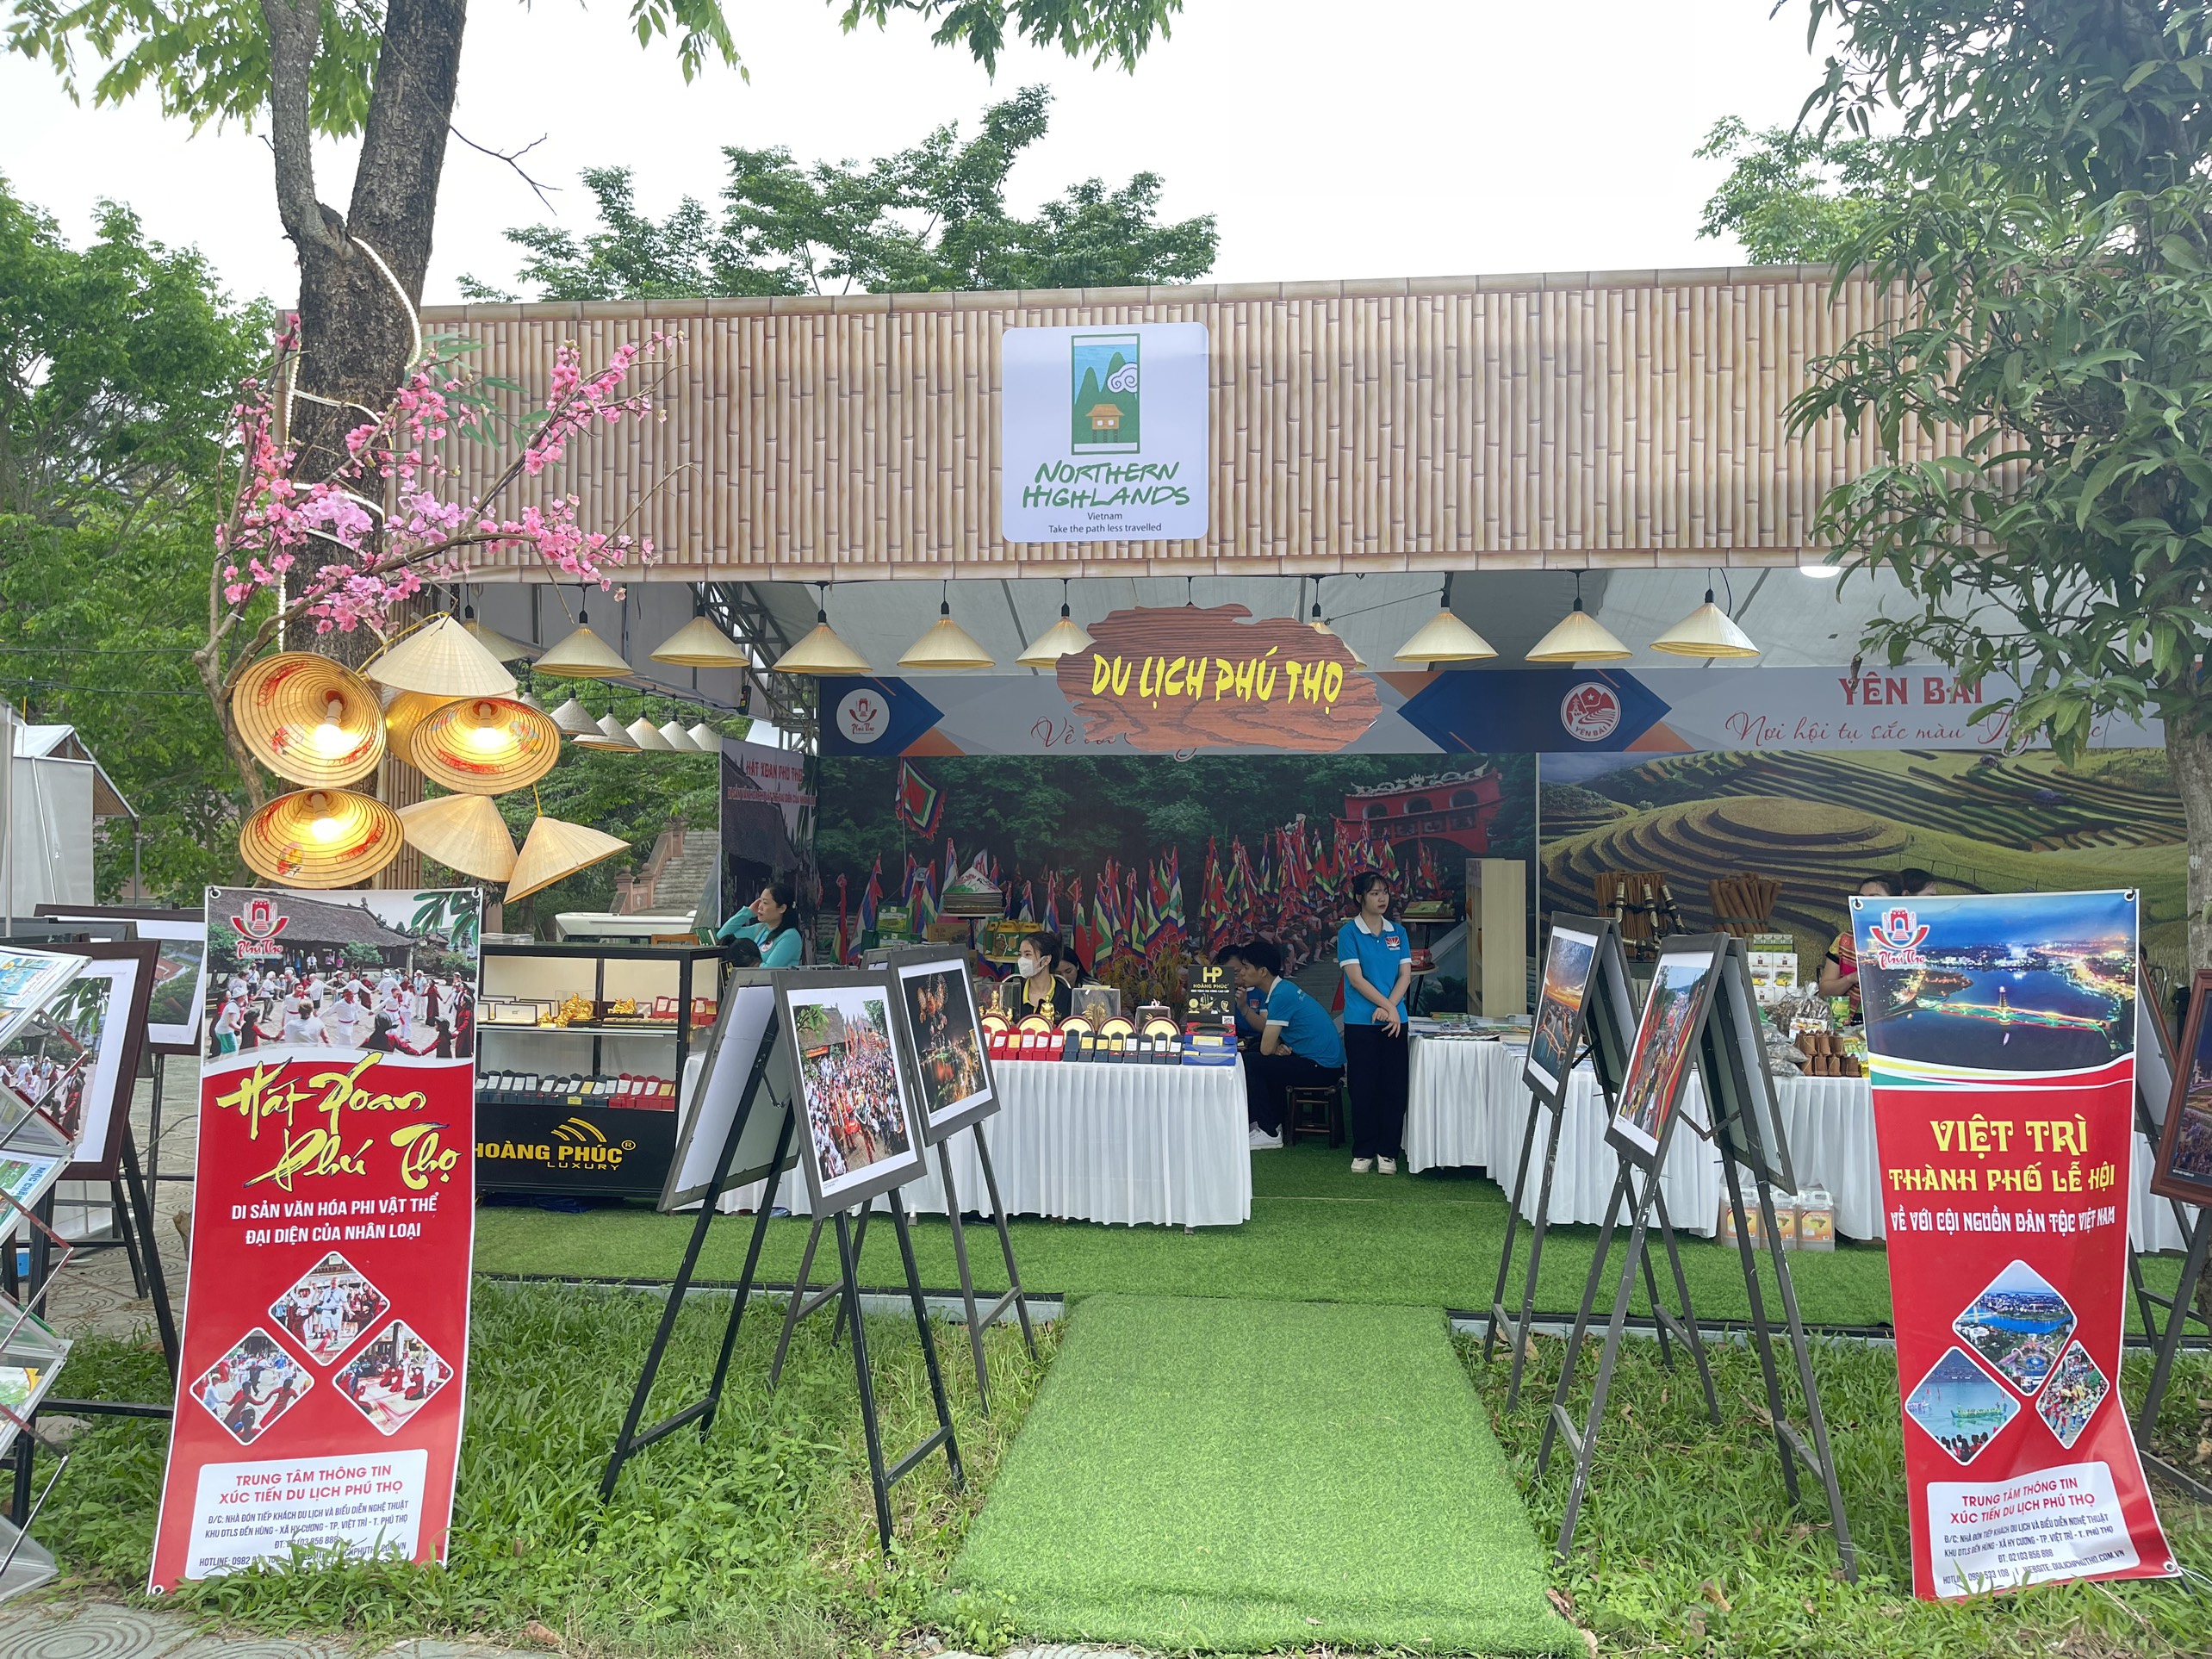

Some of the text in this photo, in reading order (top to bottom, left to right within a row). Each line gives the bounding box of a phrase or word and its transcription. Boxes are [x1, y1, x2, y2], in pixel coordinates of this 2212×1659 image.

[1035, 459, 1180, 484] NORTHERN
[1022, 485, 1190, 509] HIGHLANDS
[1088, 513, 1123, 521] Vietnam
[1048, 523, 1162, 536] Take the path less travelled
[1091, 645, 1344, 716] DU LỊCH PHÚ THỌ
[1838, 671, 1983, 705] YÊN BÁI
[1030, 715, 1078, 748] Về
[1575, 726, 1608, 737] YÊN BÁI
[1725, 711, 1787, 747] Nơi
[1793, 716, 1834, 744] hội
[1838, 722, 1864, 744] tụ
[1871, 720, 1911, 741] sắc
[1915, 723, 1967, 741] màu
[746, 758, 759, 776] HÁT
[761, 761, 778, 779] XOAN
[779, 763, 790, 780] PHÚ
[237, 940, 262, 959] Phú
[1879, 950, 1903, 969] Phú
[1202, 966, 1223, 983] HP
[215, 1056, 320, 1140] Hát
[1929, 1113, 2088, 1159] VIỆT TRÌ
[243, 1122, 463, 1192] Phú Thọ
[475, 1140, 623, 1164] HOÀNG PHÚC
[28, 1166, 47, 1183] MỘC
[547, 1161, 620, 1171] LUXURY
[1888, 1160, 2116, 1192] THÀNH PHỐ LỄ HỘI
[232, 1191, 440, 1220] DI SẢN VĂN HÓA PHI VẬT THỂ
[1891, 1204, 2116, 1237] VỀ VỚI CỘI NGUỒN DÂN TỘC VIỆT NAM
[245, 1222, 420, 1246] ĐẠI DIỆN CỦA NHÂN LOẠI
[236, 1465, 392, 1487] TRUNG TÂM THÔNG TIN
[219, 1480, 403, 1504] XÚC TIẾN DU LỊCH PHÚ THỌ
[1962, 1477, 2078, 1507] TRUNG TÂM THÔNG TIN
[208, 1500, 409, 1524] Đ/C: NHÀ ĐÓN TIẾP KHÁCH DU LỊCH VÀ BIỂU DIỄN NGHỆ THUẬT
[1950, 1493, 2095, 1524] XÚC TIẾN DU LỊCH PHÚ THỌ
[221, 1528, 239, 1538] DTLS
[254, 1525, 273, 1535] HÙNG
[279, 1525, 289, 1534] XÃ
[341, 1519, 356, 1530] VIỆT
[357, 1517, 368, 1527] TRÌ
[381, 1514, 394, 1525] PHÚ
[395, 1514, 408, 1524] THỌ
[1944, 1535, 1960, 1544] Đ/C:
[1960, 1533, 1972, 1543] NHÀ
[2019, 1522, 2031, 1533] LỊCH
[2032, 1520, 2040, 1530] VÀ
[2086, 1513, 2109, 1524] THUẬT
[275, 1540, 285, 1549] ĐT:
[1944, 1549, 1957, 1557] KHU
[1998, 1538, 2007, 1548] XÃ
[2007, 1538, 2016, 1547] HY
[2050, 1532, 2063, 1543] VIỆT
[2064, 1530, 2074, 1539] TRÌ
[2086, 1528, 2100, 1537] PHÚ
[2101, 1525, 2114, 1534] THỌ
[199, 1556, 231, 1567] HOTLINE:
[232, 1556, 251, 1565] 0982
[1998, 1554, 2008, 1563] ĐT:
[2008, 1551, 2028, 1562] 02103
[2029, 1550, 2041, 1559] 856
[1968, 1572, 1982, 1581] 098
[1998, 1568, 2010, 1578] 108
